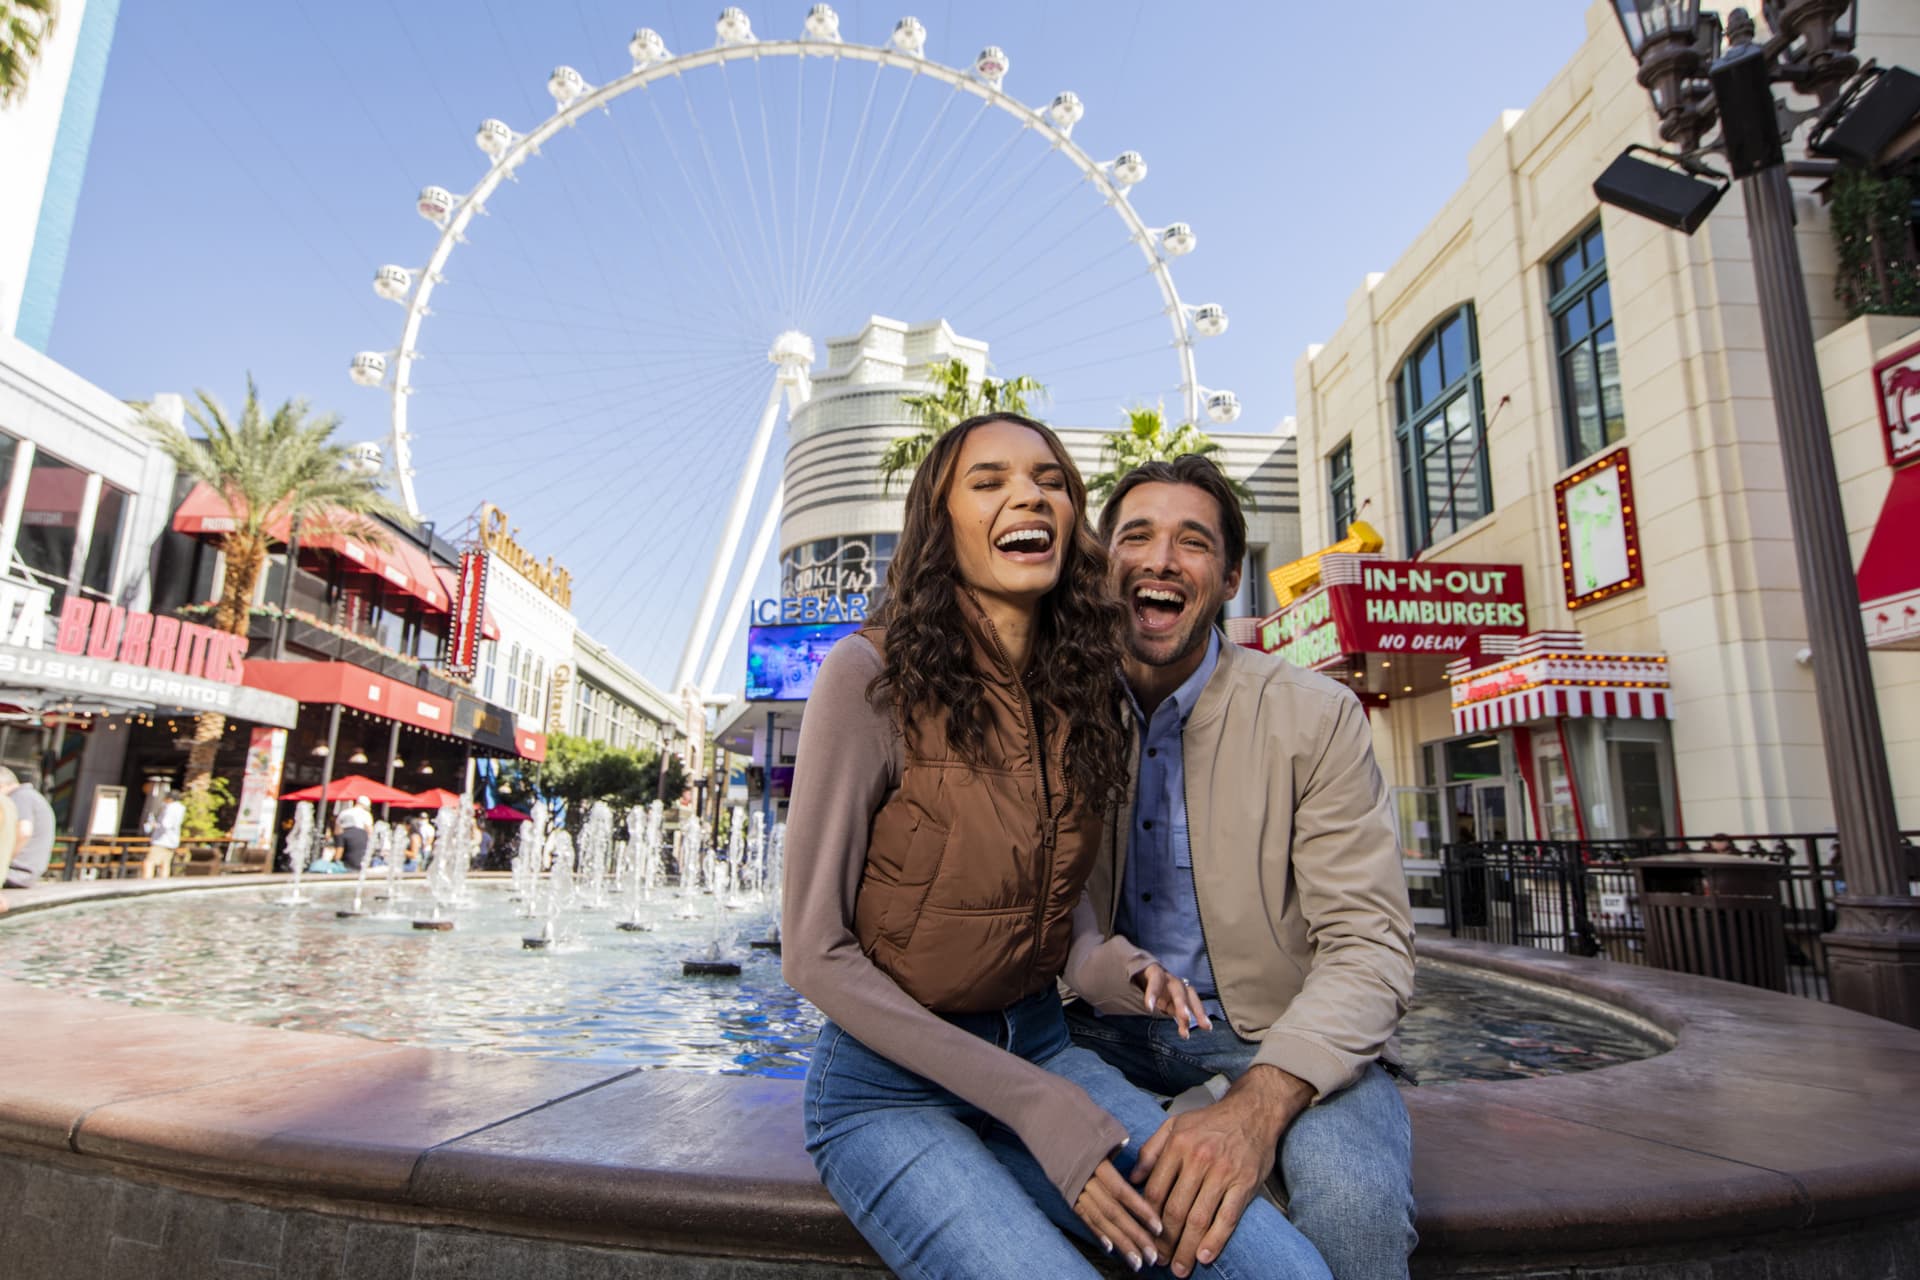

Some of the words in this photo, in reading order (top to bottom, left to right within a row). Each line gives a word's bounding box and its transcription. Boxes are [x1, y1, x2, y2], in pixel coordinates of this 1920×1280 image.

[1364, 567, 1507, 595] IN-N-OUT
[750, 593, 869, 624] ICEBAR
[1366, 599, 1526, 627] HAMBURGERS
[1378, 634, 1407, 650] NO
[1411, 634, 1468, 651] DELAY
[0, 653, 99, 683] SUSHI
[110, 671, 231, 708] BURRITOS
